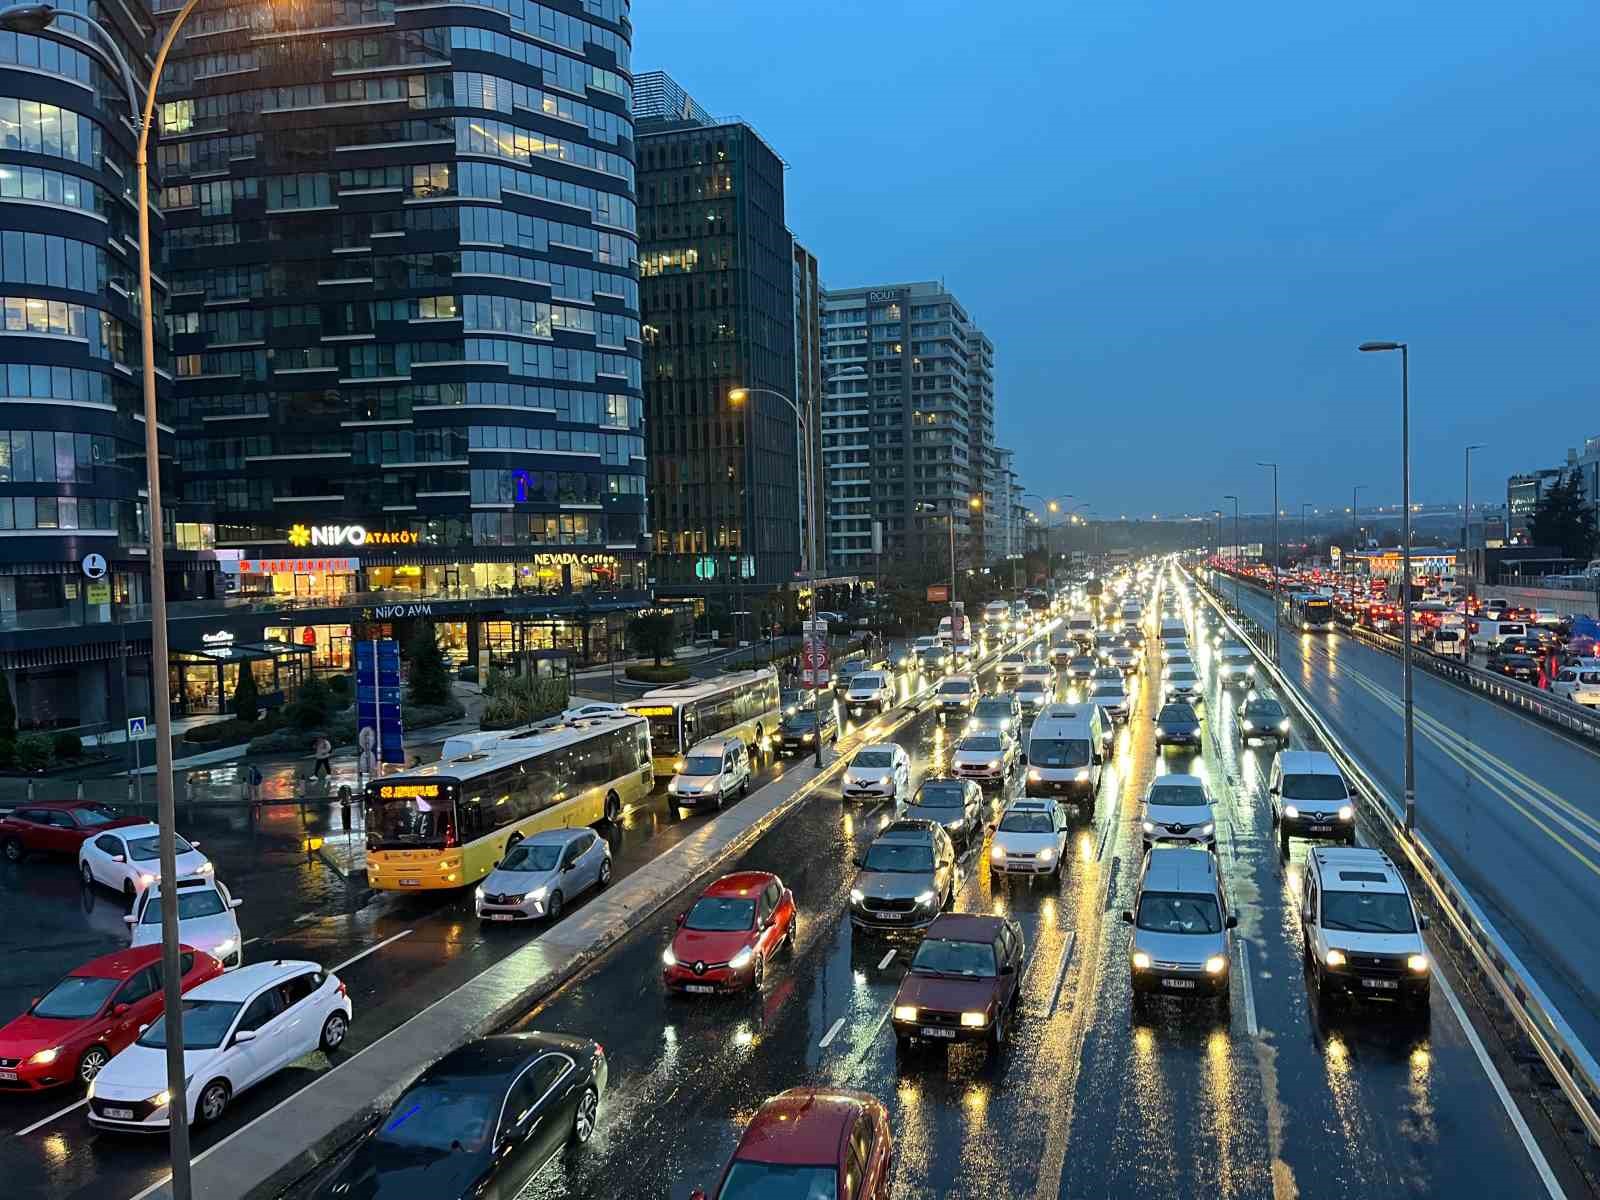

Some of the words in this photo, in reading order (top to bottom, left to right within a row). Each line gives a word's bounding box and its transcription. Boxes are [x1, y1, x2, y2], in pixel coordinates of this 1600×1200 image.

[365, 530, 419, 544] ATAKÖY
[534, 553, 579, 565] NEVADA
[580, 554, 614, 564] Coffee
[407, 604, 432, 617] AVM
